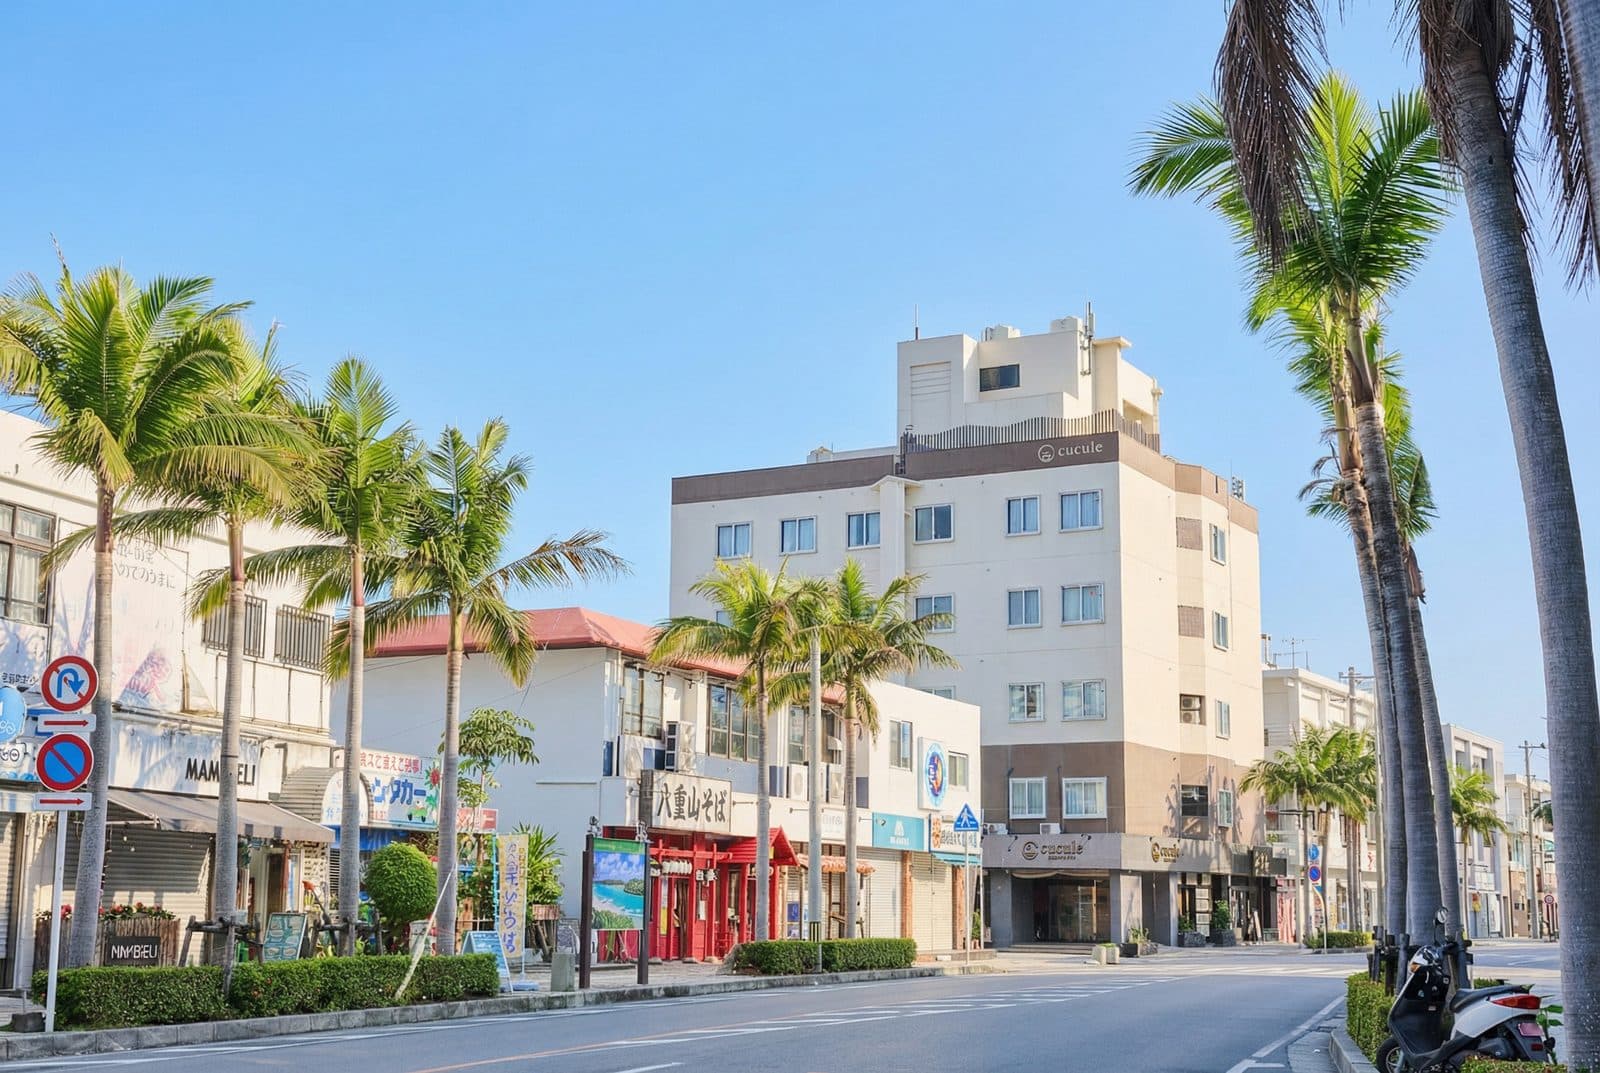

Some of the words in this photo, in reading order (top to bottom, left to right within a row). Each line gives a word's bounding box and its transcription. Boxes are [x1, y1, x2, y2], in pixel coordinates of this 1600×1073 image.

[1058, 441, 1103, 456] cucule
[657, 783, 726, 823] 八重山そば
[1041, 840, 1083, 855] cucule
